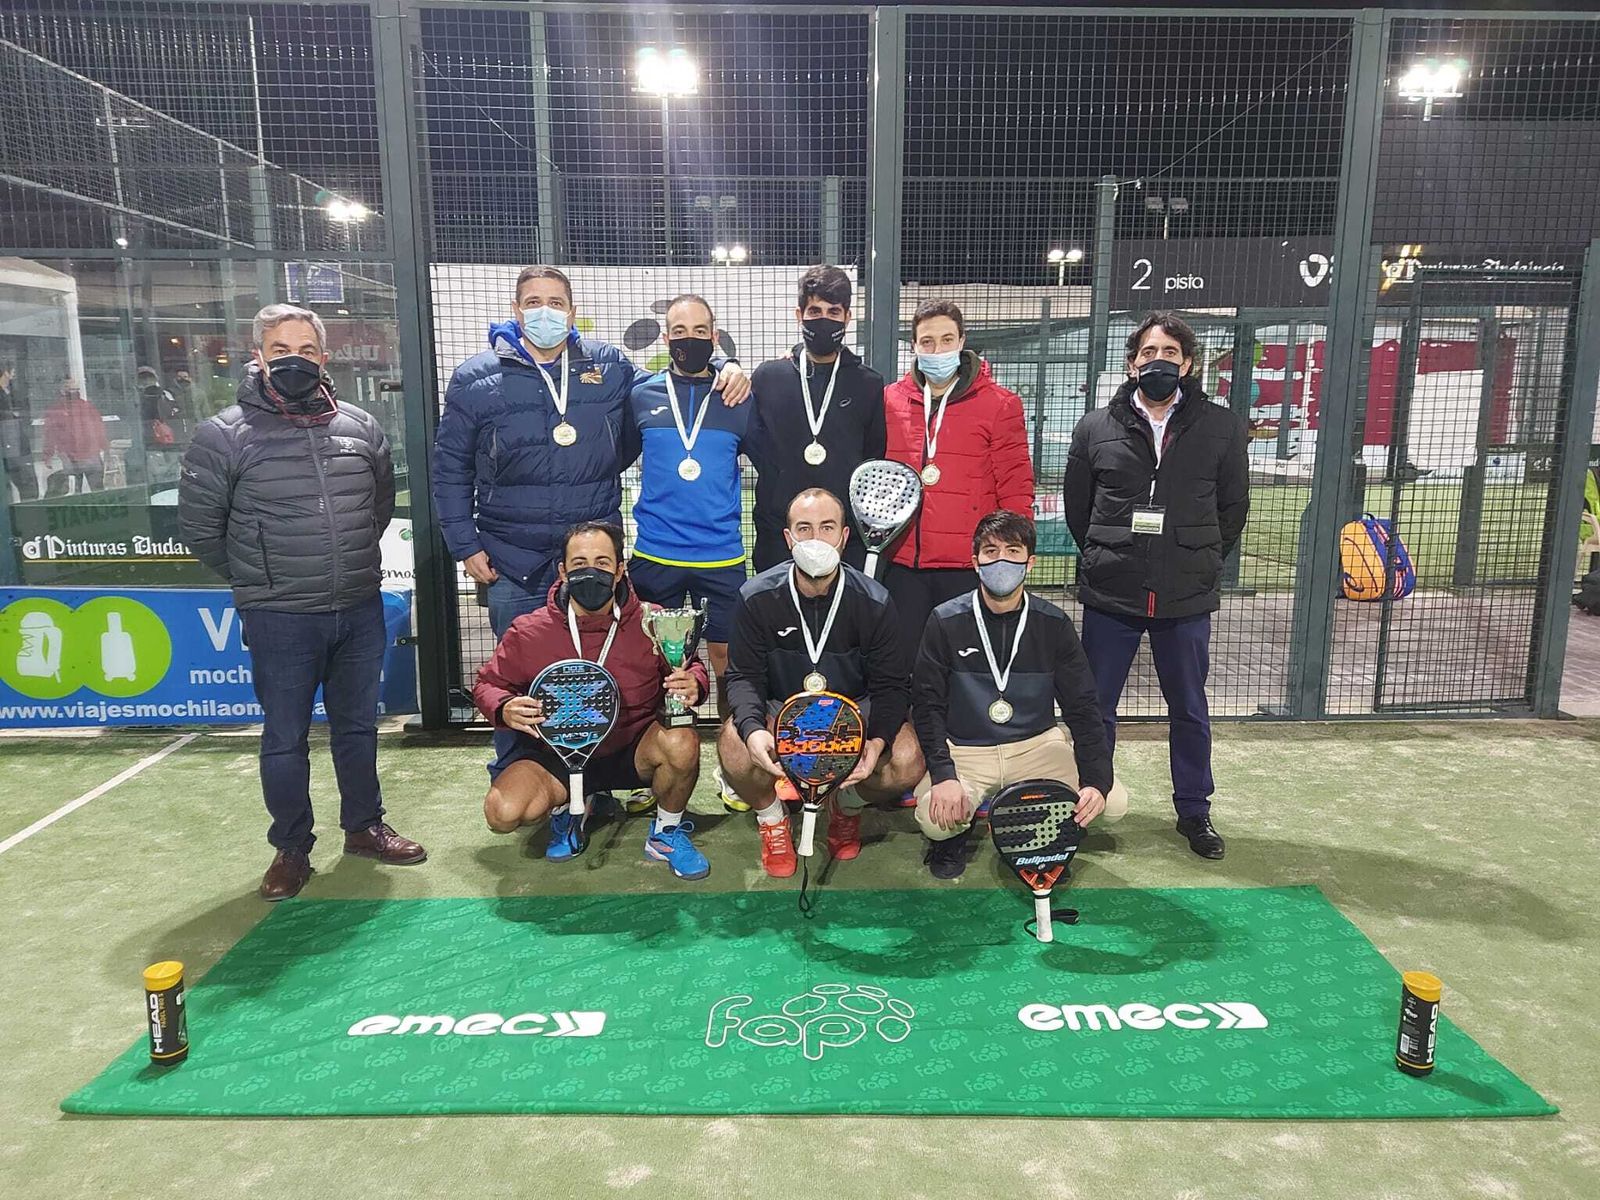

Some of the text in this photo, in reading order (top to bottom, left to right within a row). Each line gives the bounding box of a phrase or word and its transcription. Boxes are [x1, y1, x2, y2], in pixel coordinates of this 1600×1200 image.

[1131, 258, 1204, 294] 2 pista
[44, 534, 127, 559] Pinturas
[1016, 852, 1070, 866] Bullpadel
[149, 993, 163, 1053] HEAD
[347, 1013, 549, 1037] emec
[1018, 1003, 1211, 1031] emec
[1426, 1004, 1439, 1063] HEAD
